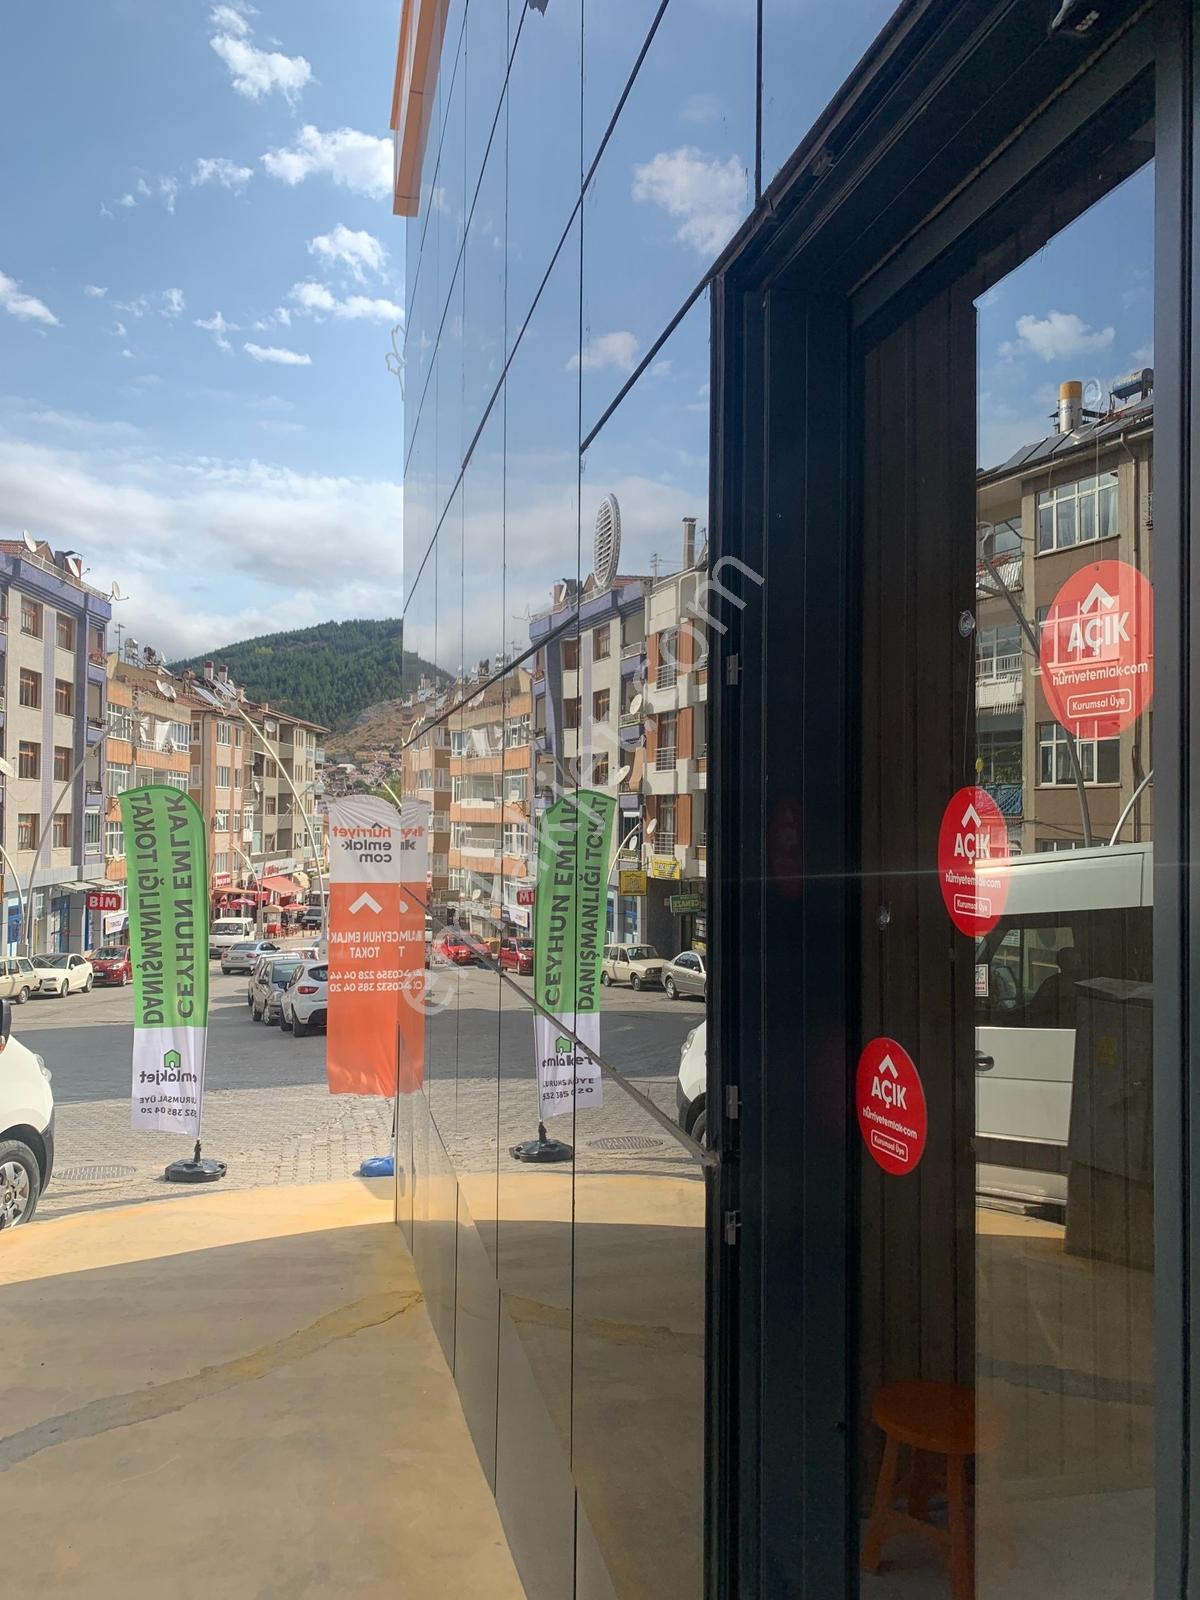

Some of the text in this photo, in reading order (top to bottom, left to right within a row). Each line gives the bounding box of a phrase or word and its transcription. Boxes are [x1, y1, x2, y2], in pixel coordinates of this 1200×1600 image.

[1067, 611, 1131, 656] AÇIK
[1072, 694, 1126, 711] Kurumsal Üye
[953, 832, 991, 864] AÇIK
[89, 894, 117, 908] BİM
[545, 895, 571, 1006] CEYHUN
[577, 865, 602, 1010] DANIŞMANLIĞI
[870, 1075, 908, 1110] AÇIK
